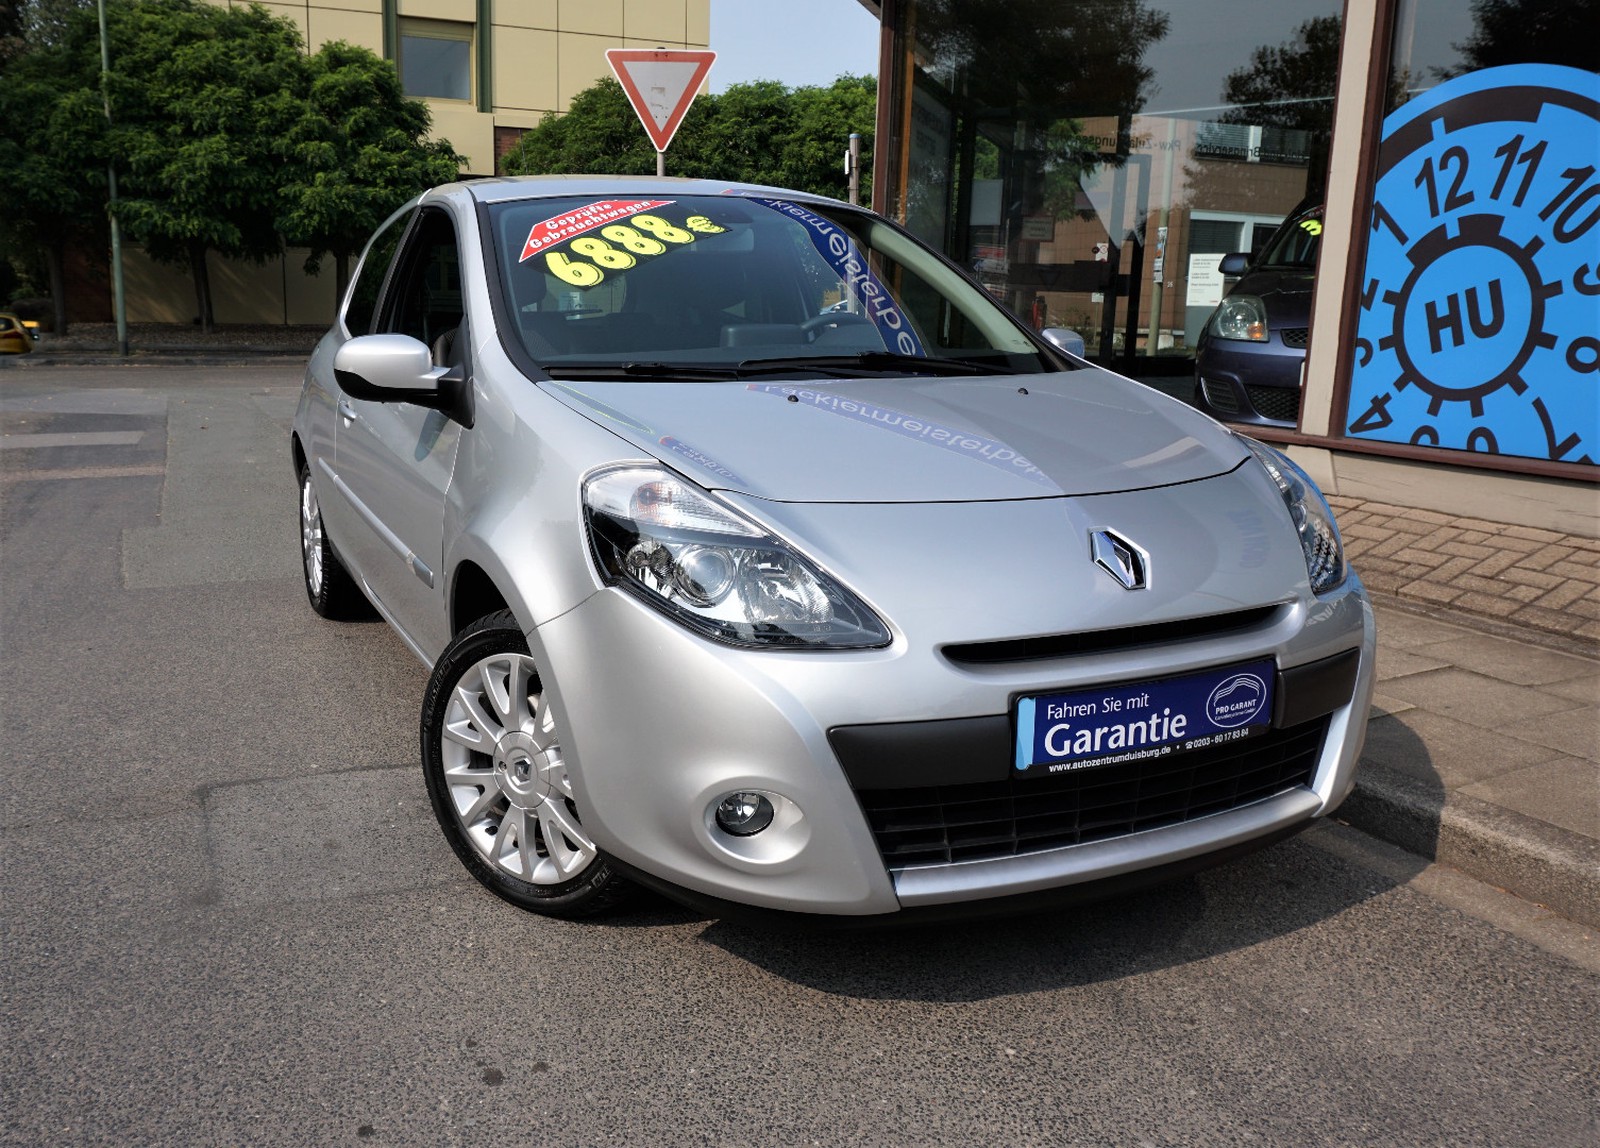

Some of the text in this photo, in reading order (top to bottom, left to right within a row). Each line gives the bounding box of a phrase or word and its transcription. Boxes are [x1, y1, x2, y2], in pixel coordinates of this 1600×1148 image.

[1414, 145, 1474, 218] 12
[1489, 134, 1548, 207] 11
[529, 201, 650, 249] Gebrauchtwagen
[546, 202, 613, 230] Geprüfte
[1372, 201, 1409, 246] 1
[1538, 165, 1600, 243] 10
[545, 215, 695, 286] 6888
[1425, 279, 1505, 354] HU
[1348, 392, 1393, 434] 4
[1047, 692, 1150, 720] Fahren Sie mit
[1215, 705, 1229, 715] PRO
[1230, 699, 1257, 711] GARANT
[1044, 707, 1187, 757] Garantie
[1049, 746, 1171, 772] www.autozentrumduisburg.de
